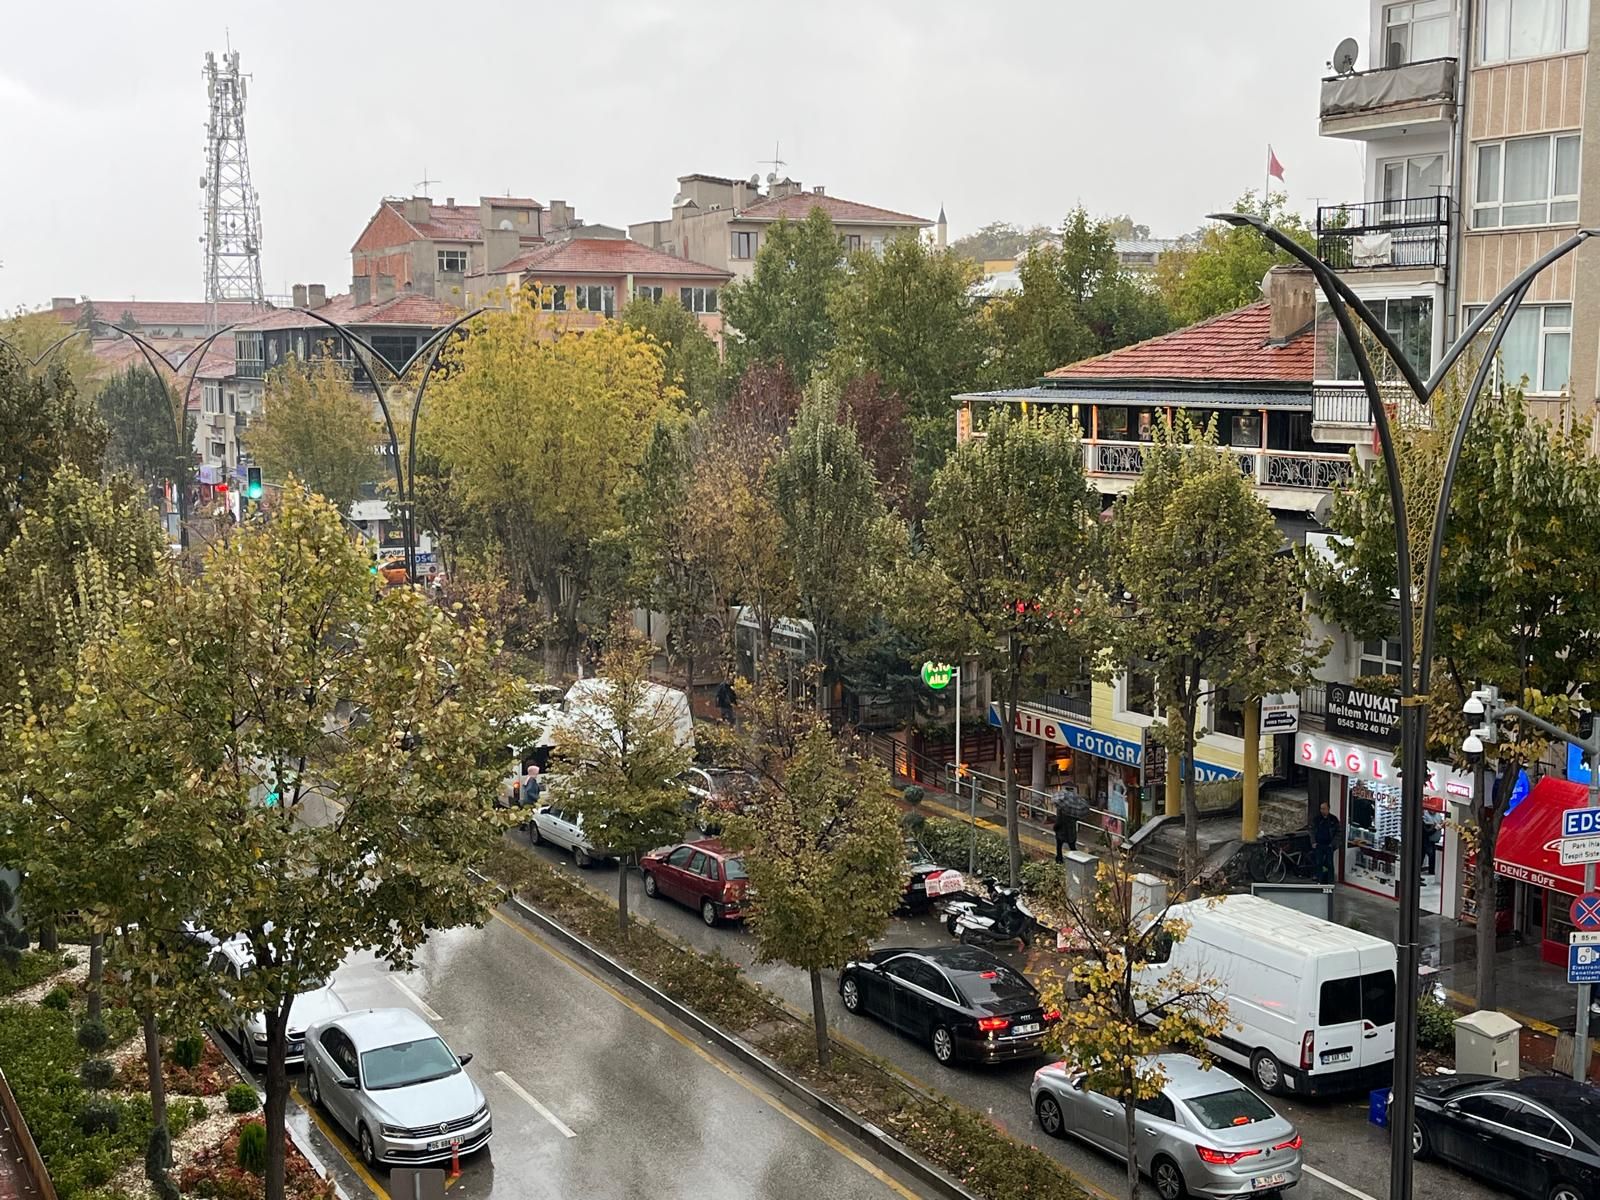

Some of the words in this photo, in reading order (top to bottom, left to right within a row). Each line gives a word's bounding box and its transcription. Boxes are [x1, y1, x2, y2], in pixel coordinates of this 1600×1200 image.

[1328, 702, 1361, 719] Meltem
[1347, 690, 1399, 713] AVUKAT
[1015, 710, 1056, 739] Aile
[1337, 718, 1354, 728] 0545
[1355, 721, 1369, 731] 392
[1370, 724, 1379, 734] 40
[1380, 726, 1390, 736] 67
[1567, 811, 1600, 832] EDS
[1572, 842, 1586, 850] Park
[1588, 840, 1600, 848] İhla
[1565, 852, 1583, 861] Tespit
[1584, 850, 1600, 858] Siste
[1500, 864, 1528, 880] DENİZ
[1531, 873, 1556, 887] BÜFE
